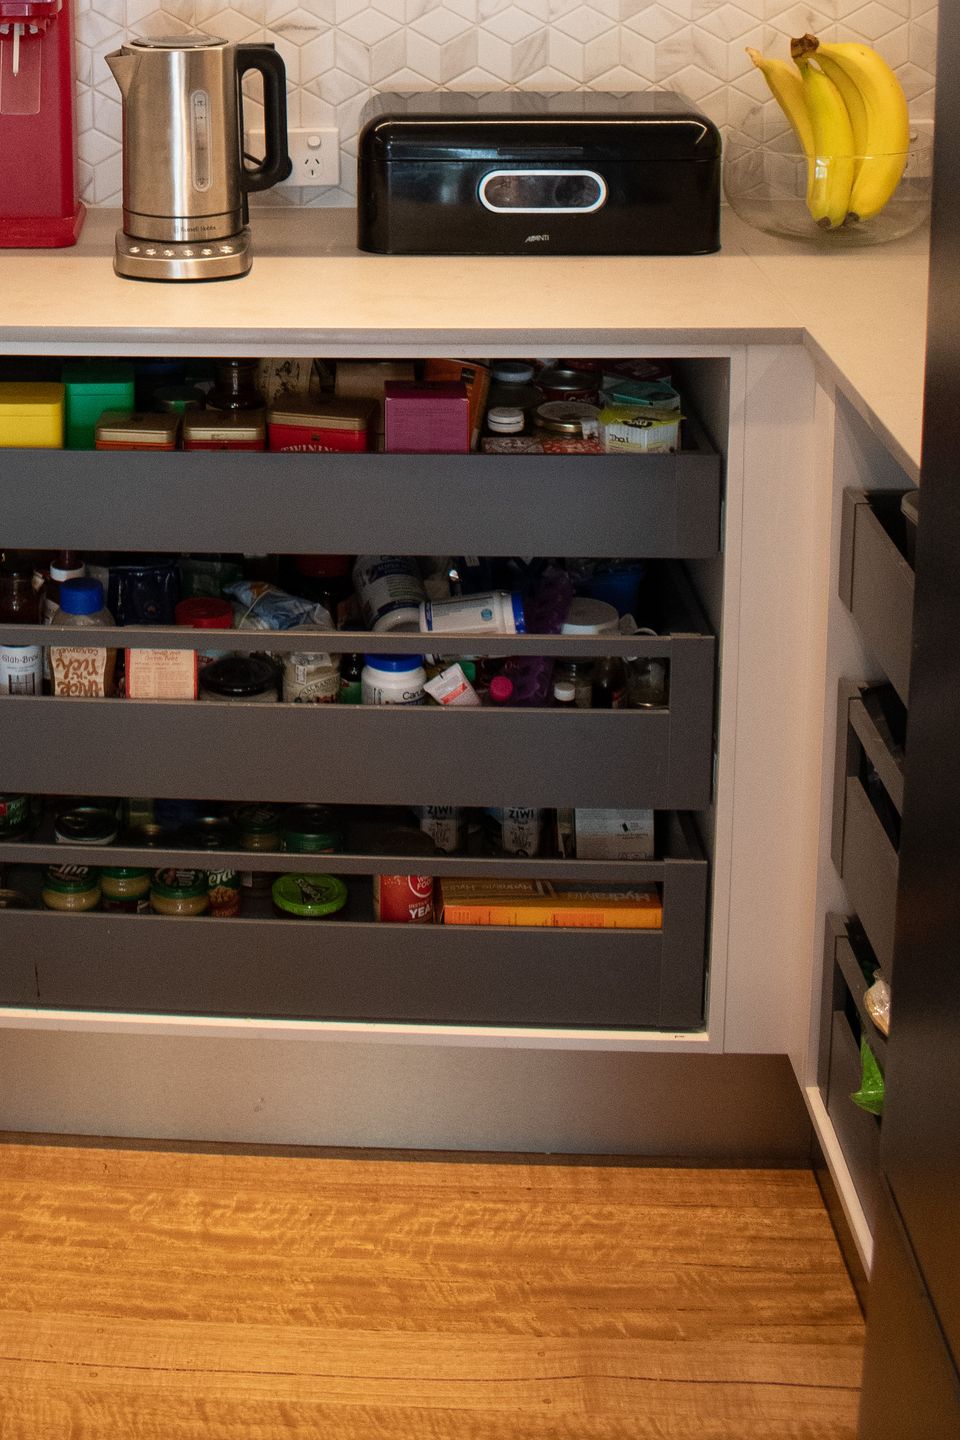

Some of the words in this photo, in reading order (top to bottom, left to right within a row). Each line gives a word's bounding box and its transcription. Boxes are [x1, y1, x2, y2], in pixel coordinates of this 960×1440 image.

[54, 656, 98, 679] rich
[428, 805, 452, 815] ZIWI
[509, 809, 534, 819] ZIWI
